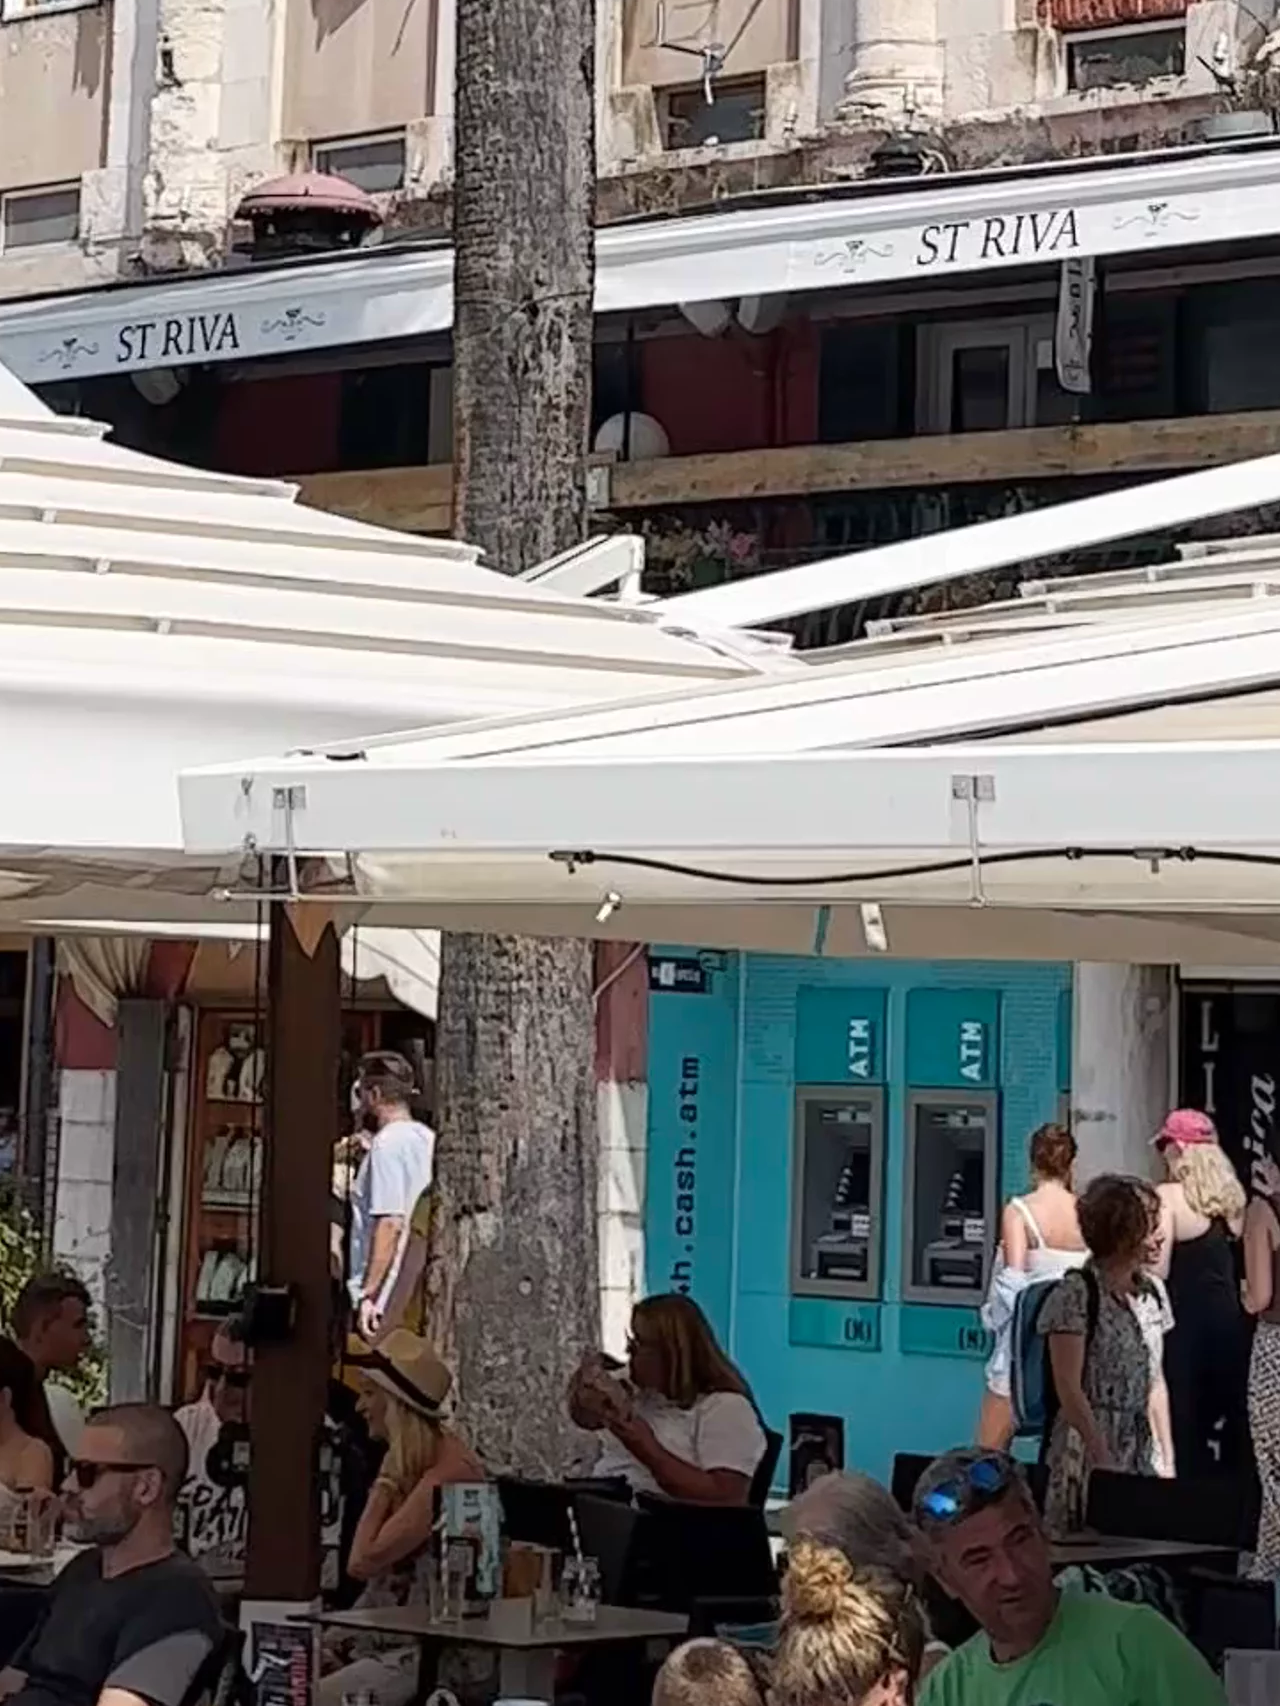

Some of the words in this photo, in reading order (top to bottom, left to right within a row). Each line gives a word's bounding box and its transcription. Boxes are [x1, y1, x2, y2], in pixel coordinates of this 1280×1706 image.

[917, 221, 970, 265] ST
[980, 209, 1080, 258] RIVA
[117, 323, 156, 362] ST
[161, 313, 240, 356] RIVA
[849, 1018, 870, 1078] ATM
[960, 1020, 983, 1082] ATM
